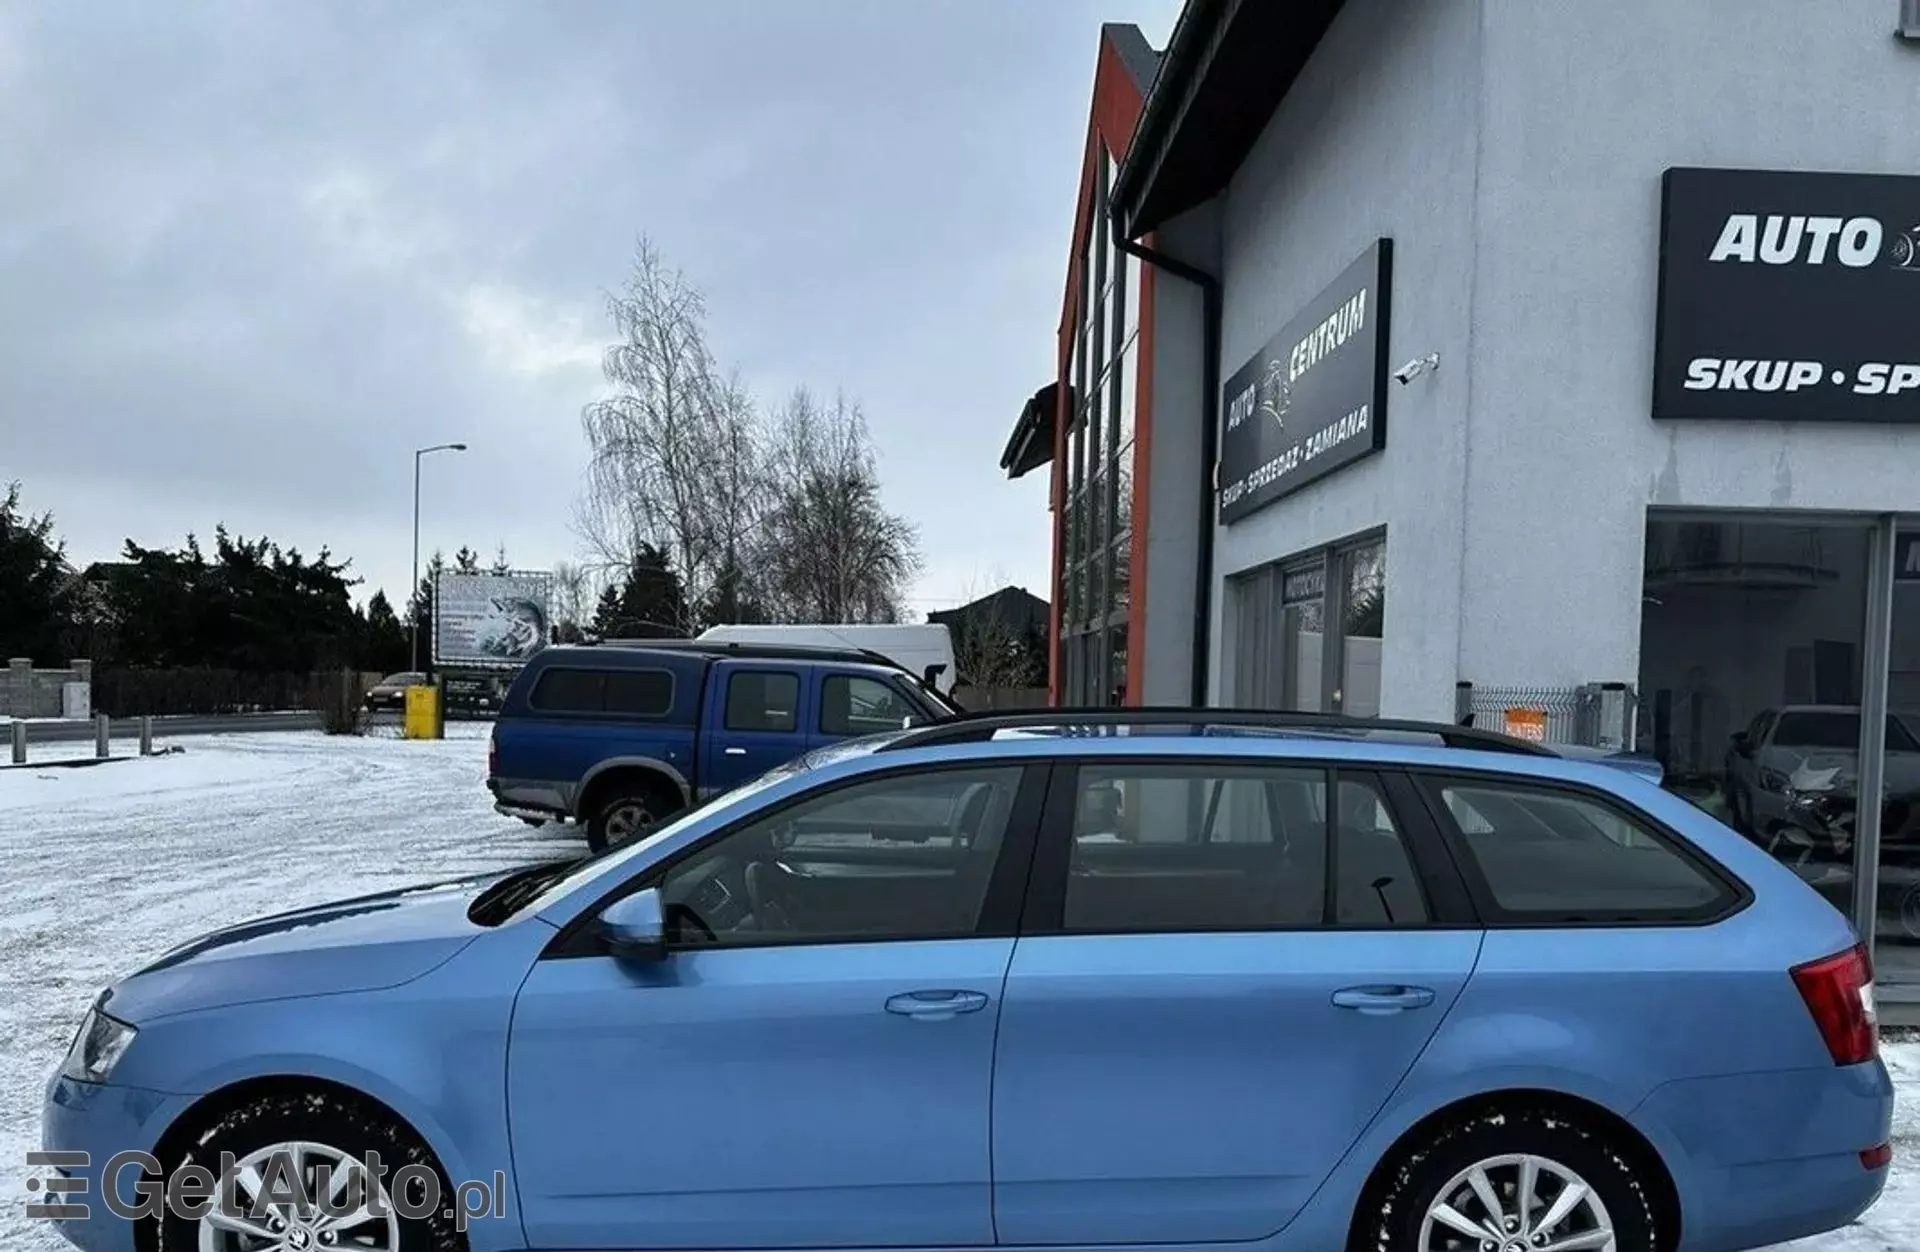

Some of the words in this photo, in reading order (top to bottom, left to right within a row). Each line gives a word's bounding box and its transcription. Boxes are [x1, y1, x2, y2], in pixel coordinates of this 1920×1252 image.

[1708, 214, 1884, 268] AUTO
[1227, 383, 1256, 432] AUTO
[1289, 287, 1367, 383] CENTRUM
[1683, 357, 1823, 392] SKUP
[1852, 362, 1920, 395] SP
[1304, 403, 1369, 462] ZAMIANA
